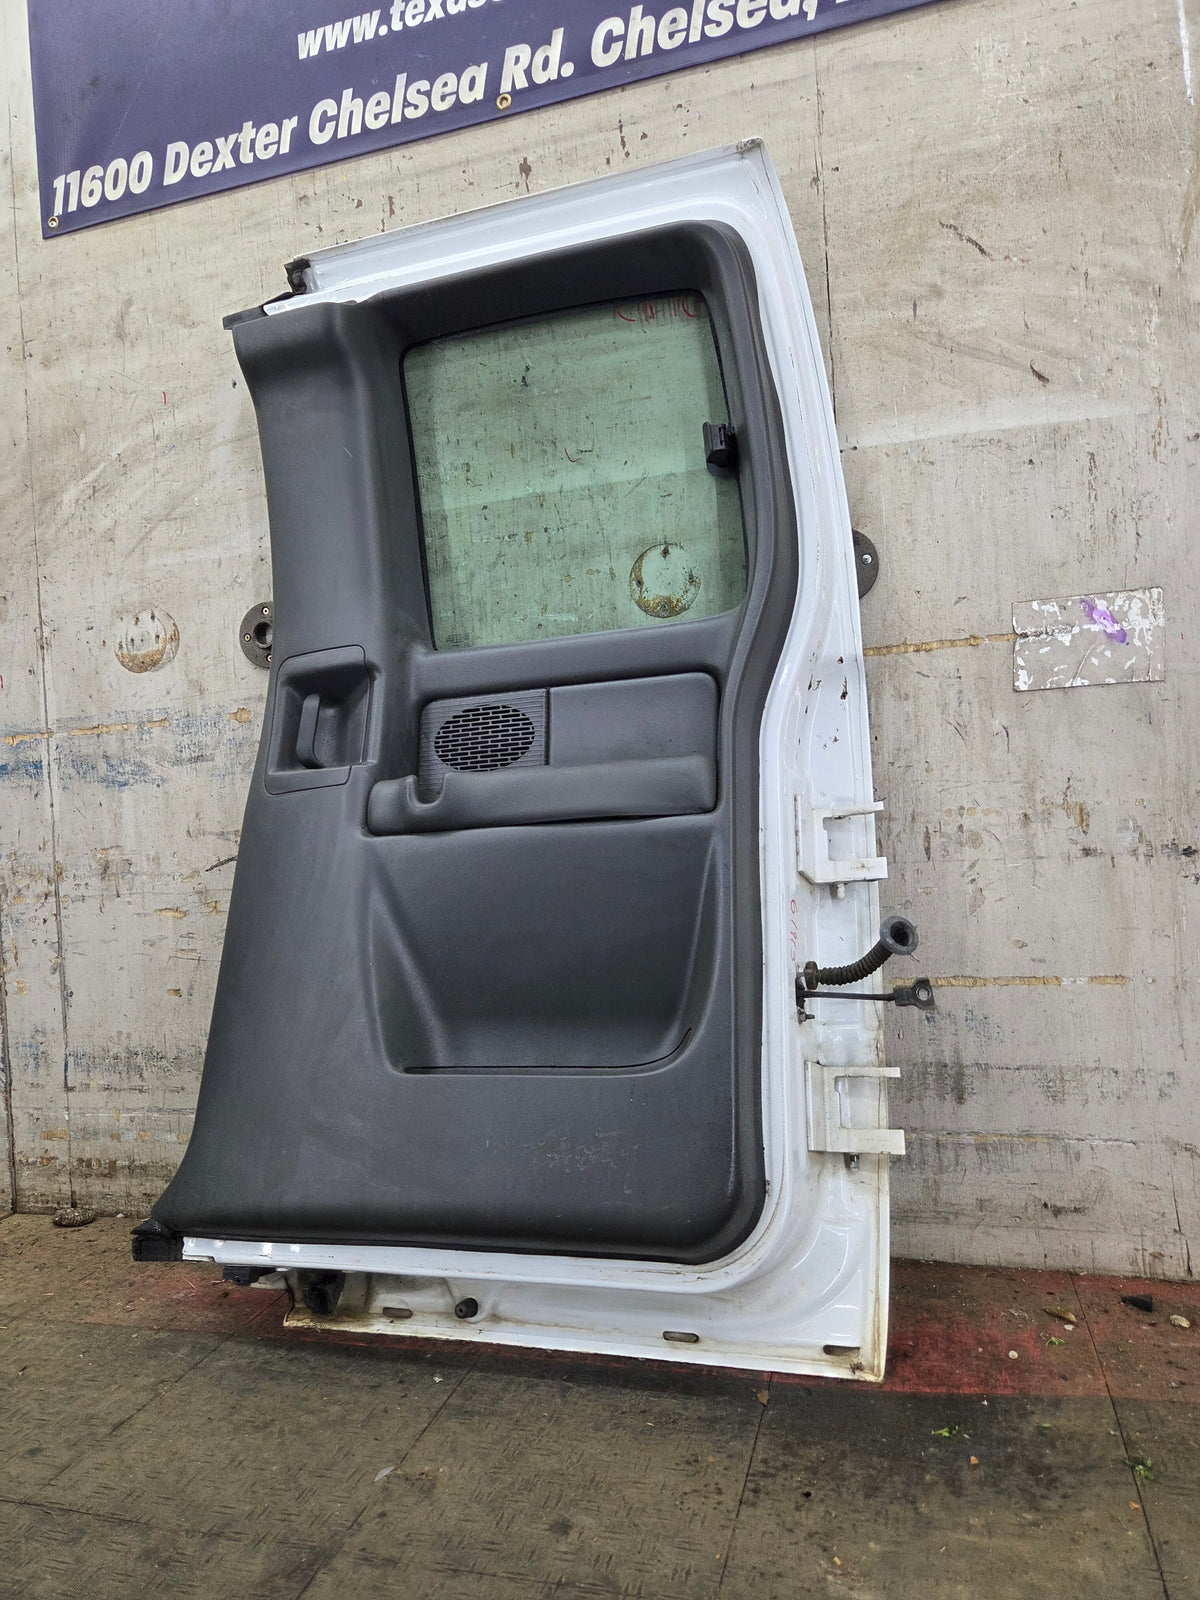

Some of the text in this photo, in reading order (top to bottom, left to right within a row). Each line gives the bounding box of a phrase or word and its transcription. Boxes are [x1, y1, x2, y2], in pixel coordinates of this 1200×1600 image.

[52, 0, 819, 217] 11600 Dexter Chelsea Rd. Chelsea,
